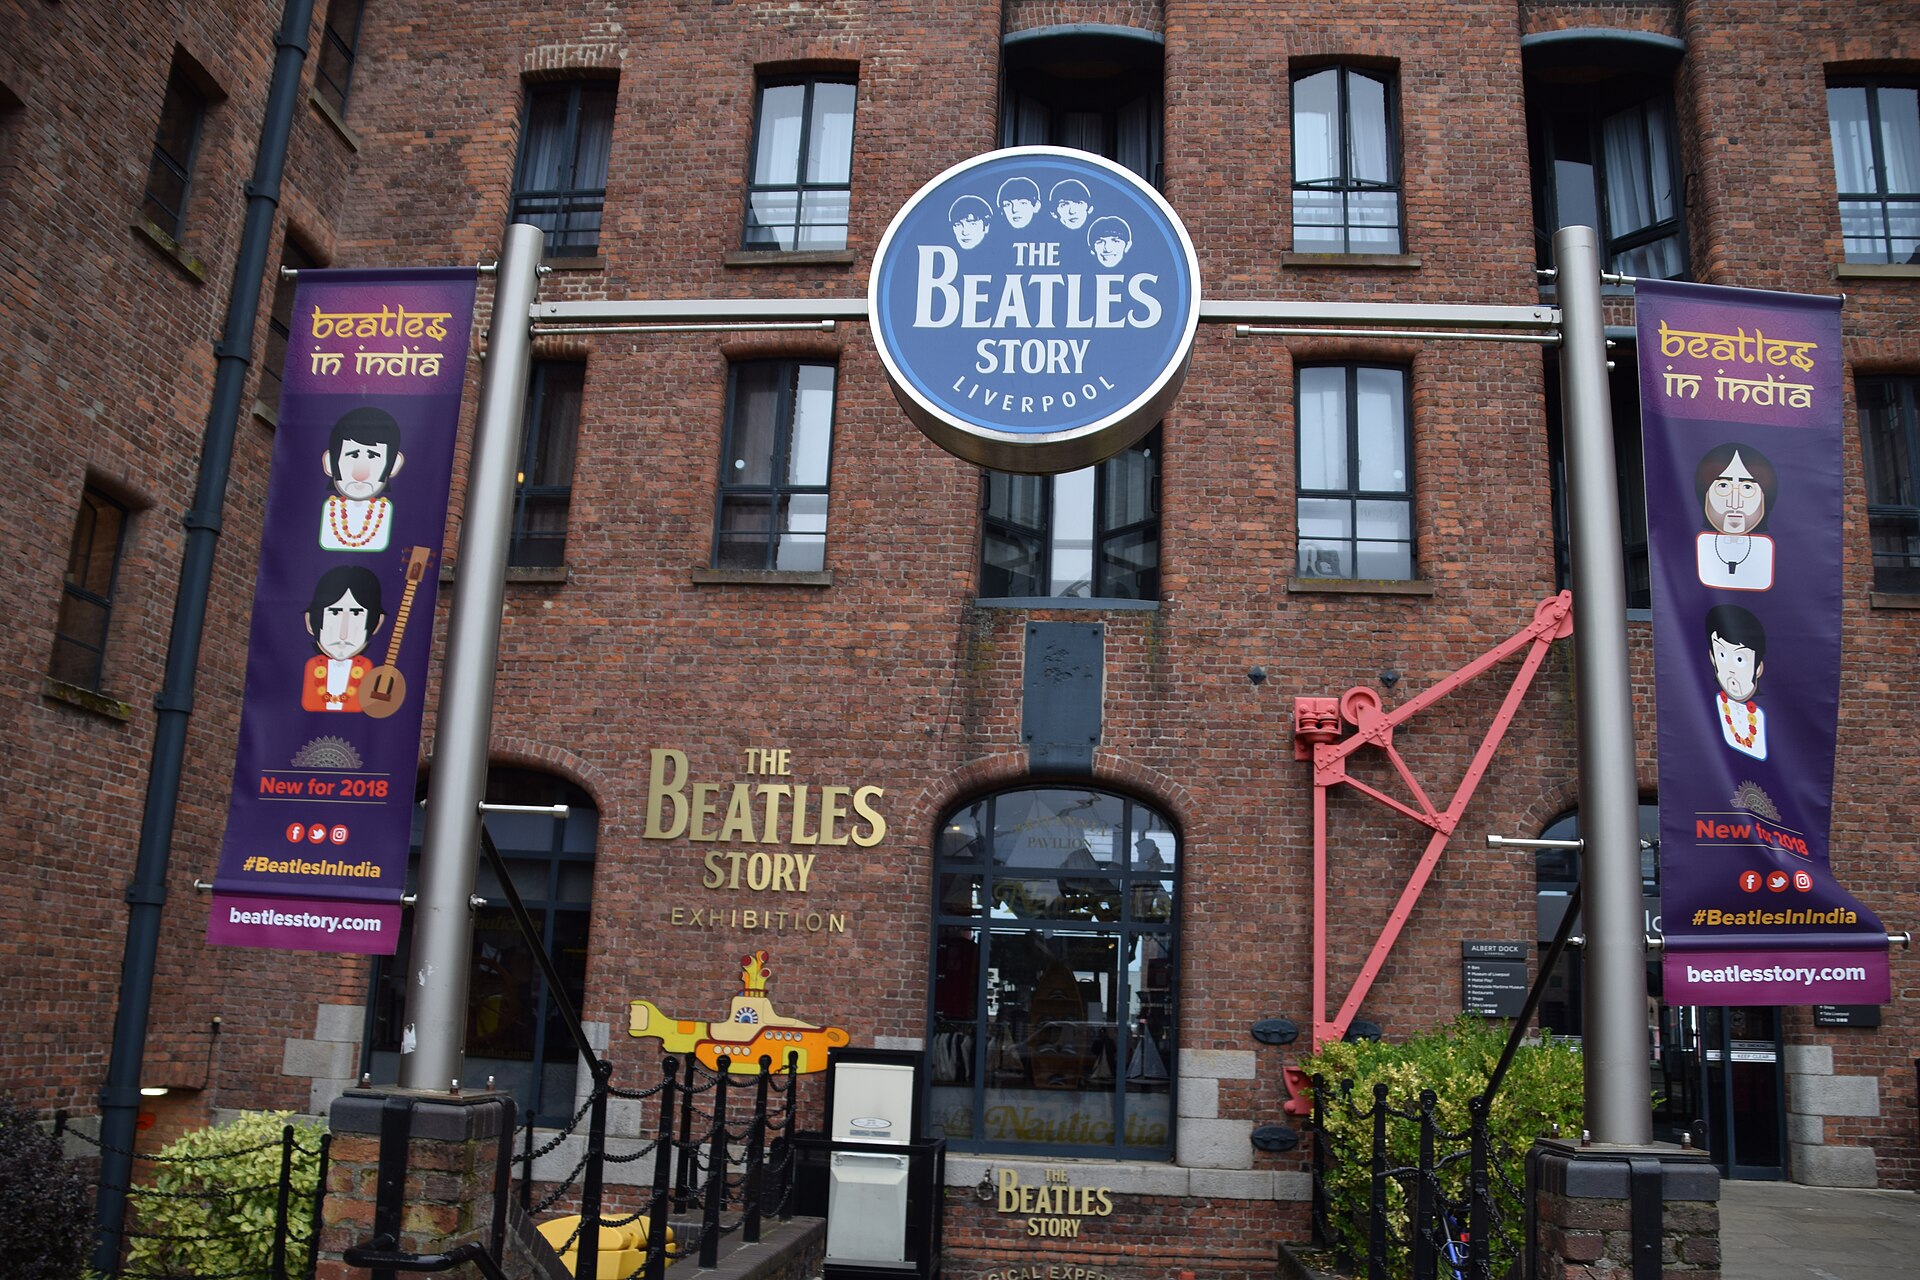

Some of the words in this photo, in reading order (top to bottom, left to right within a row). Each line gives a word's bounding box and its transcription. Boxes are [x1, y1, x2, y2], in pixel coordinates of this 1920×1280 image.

[1013, 242, 1060, 266] THE
[912, 244, 1163, 329] BEATLES
[311, 304, 452, 341] beatles
[310, 345, 344, 376] in
[354, 345, 444, 377] india
[975, 338, 1091, 374] STORY
[1658, 319, 1818, 373] beatles
[952, 375, 1115, 413] LIVERPOOL
[1663, 364, 1702, 399] in
[1714, 368, 1815, 408] india
[744, 748, 791, 776] THE
[259, 777, 303, 795] New
[307, 778, 335, 796] for
[339, 779, 389, 798] 2018
[642, 748, 887, 847] BEATLES
[1027, 837, 1093, 850] PAVILION
[1696, 820, 1751, 839] New
[1755, 822, 1775, 845] for
[1774, 830, 1809, 856] 2018
[243, 856, 381, 878] #BeatlesInIndia
[702, 851, 816, 892] STORY
[229, 907, 381, 933] beatlesstory.com
[670, 907, 846, 933] EXHIBITION
[1692, 907, 1857, 926] #BeatlesInIndia
[1687, 965, 1866, 986] beatlesstory.com
[1045, 1168, 1068, 1183] THE
[998, 1168, 1113, 1216] BEATLES
[1027, 1217, 1081, 1238] STORY
